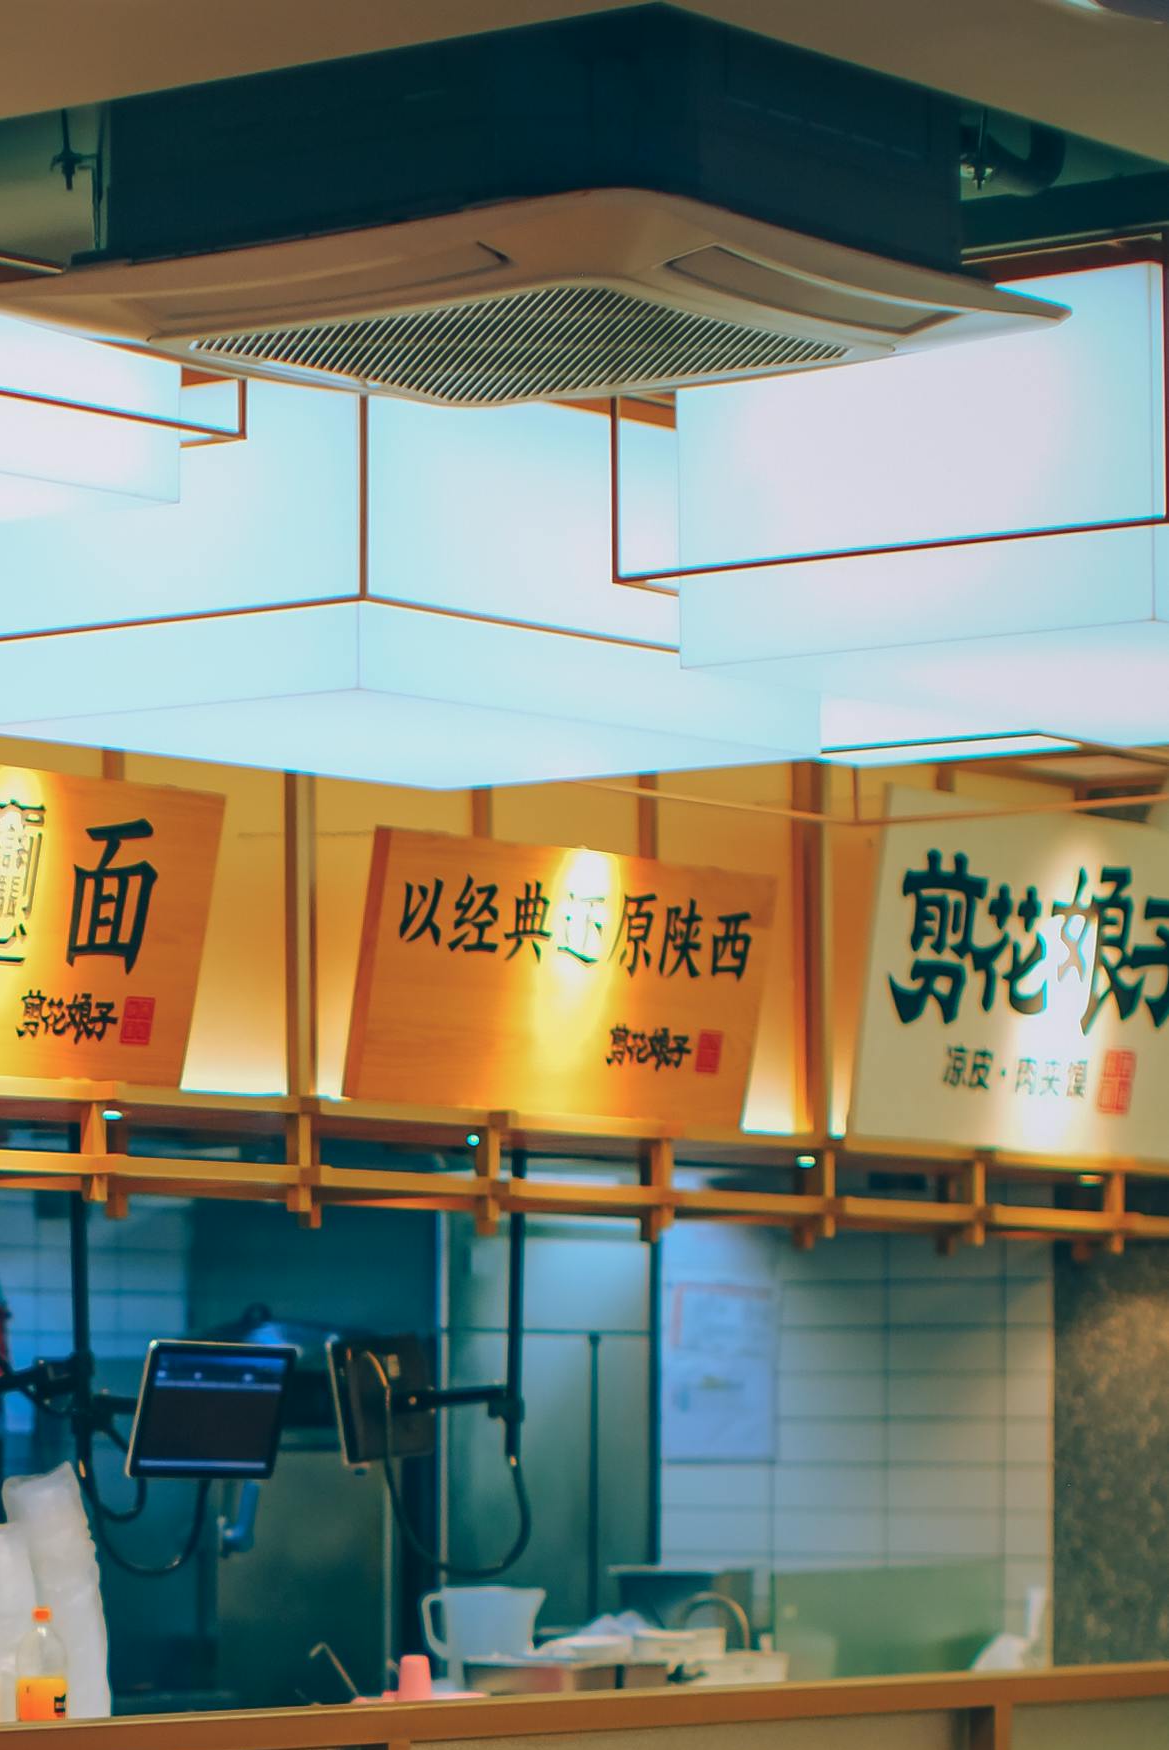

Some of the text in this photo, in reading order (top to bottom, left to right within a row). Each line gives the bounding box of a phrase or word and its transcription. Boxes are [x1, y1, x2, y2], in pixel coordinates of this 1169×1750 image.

[399, 873, 753, 982] 以经典还原陕西
[16, 989, 119, 1045] 剪花娘子
